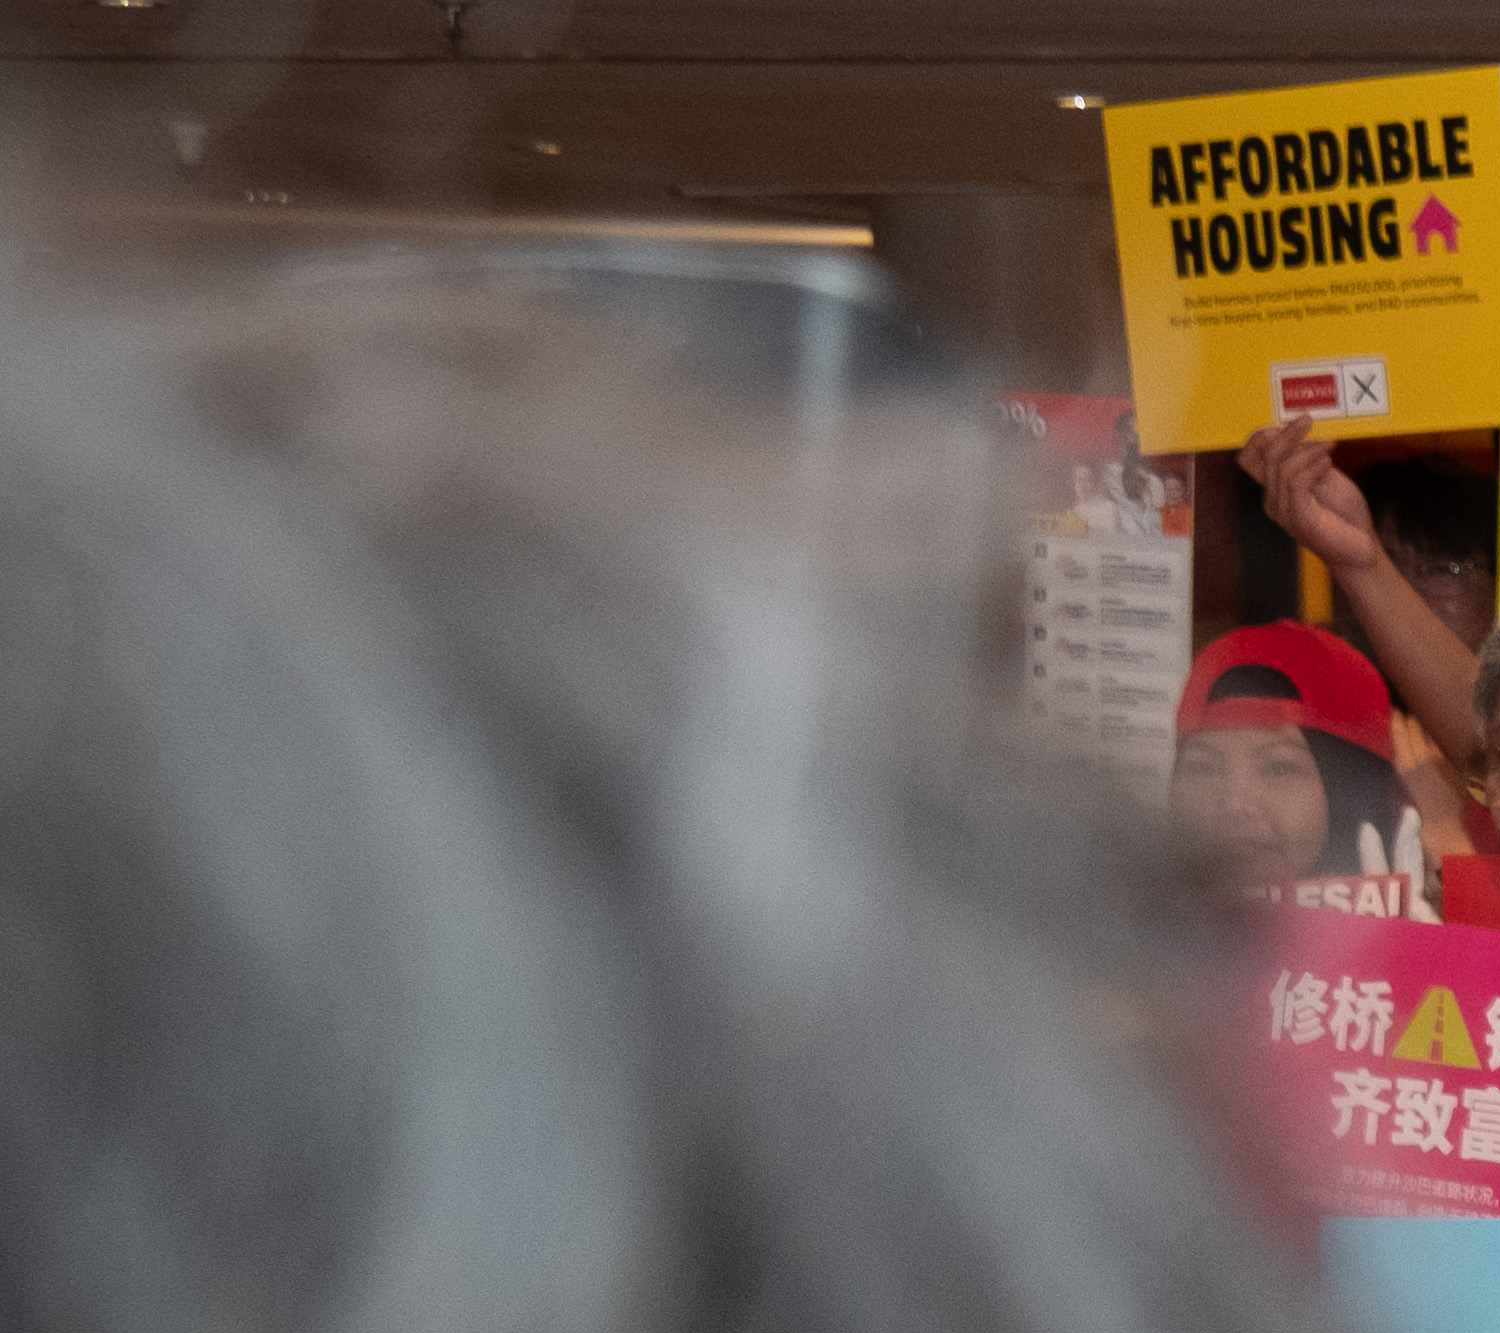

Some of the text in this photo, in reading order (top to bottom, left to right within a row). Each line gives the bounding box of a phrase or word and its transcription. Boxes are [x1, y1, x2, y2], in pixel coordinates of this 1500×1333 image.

[1150, 115, 1474, 207] AFFORDABLE
[1170, 197, 1401, 278] HOUSING
[1269, 970, 1394, 1056] 修桥
